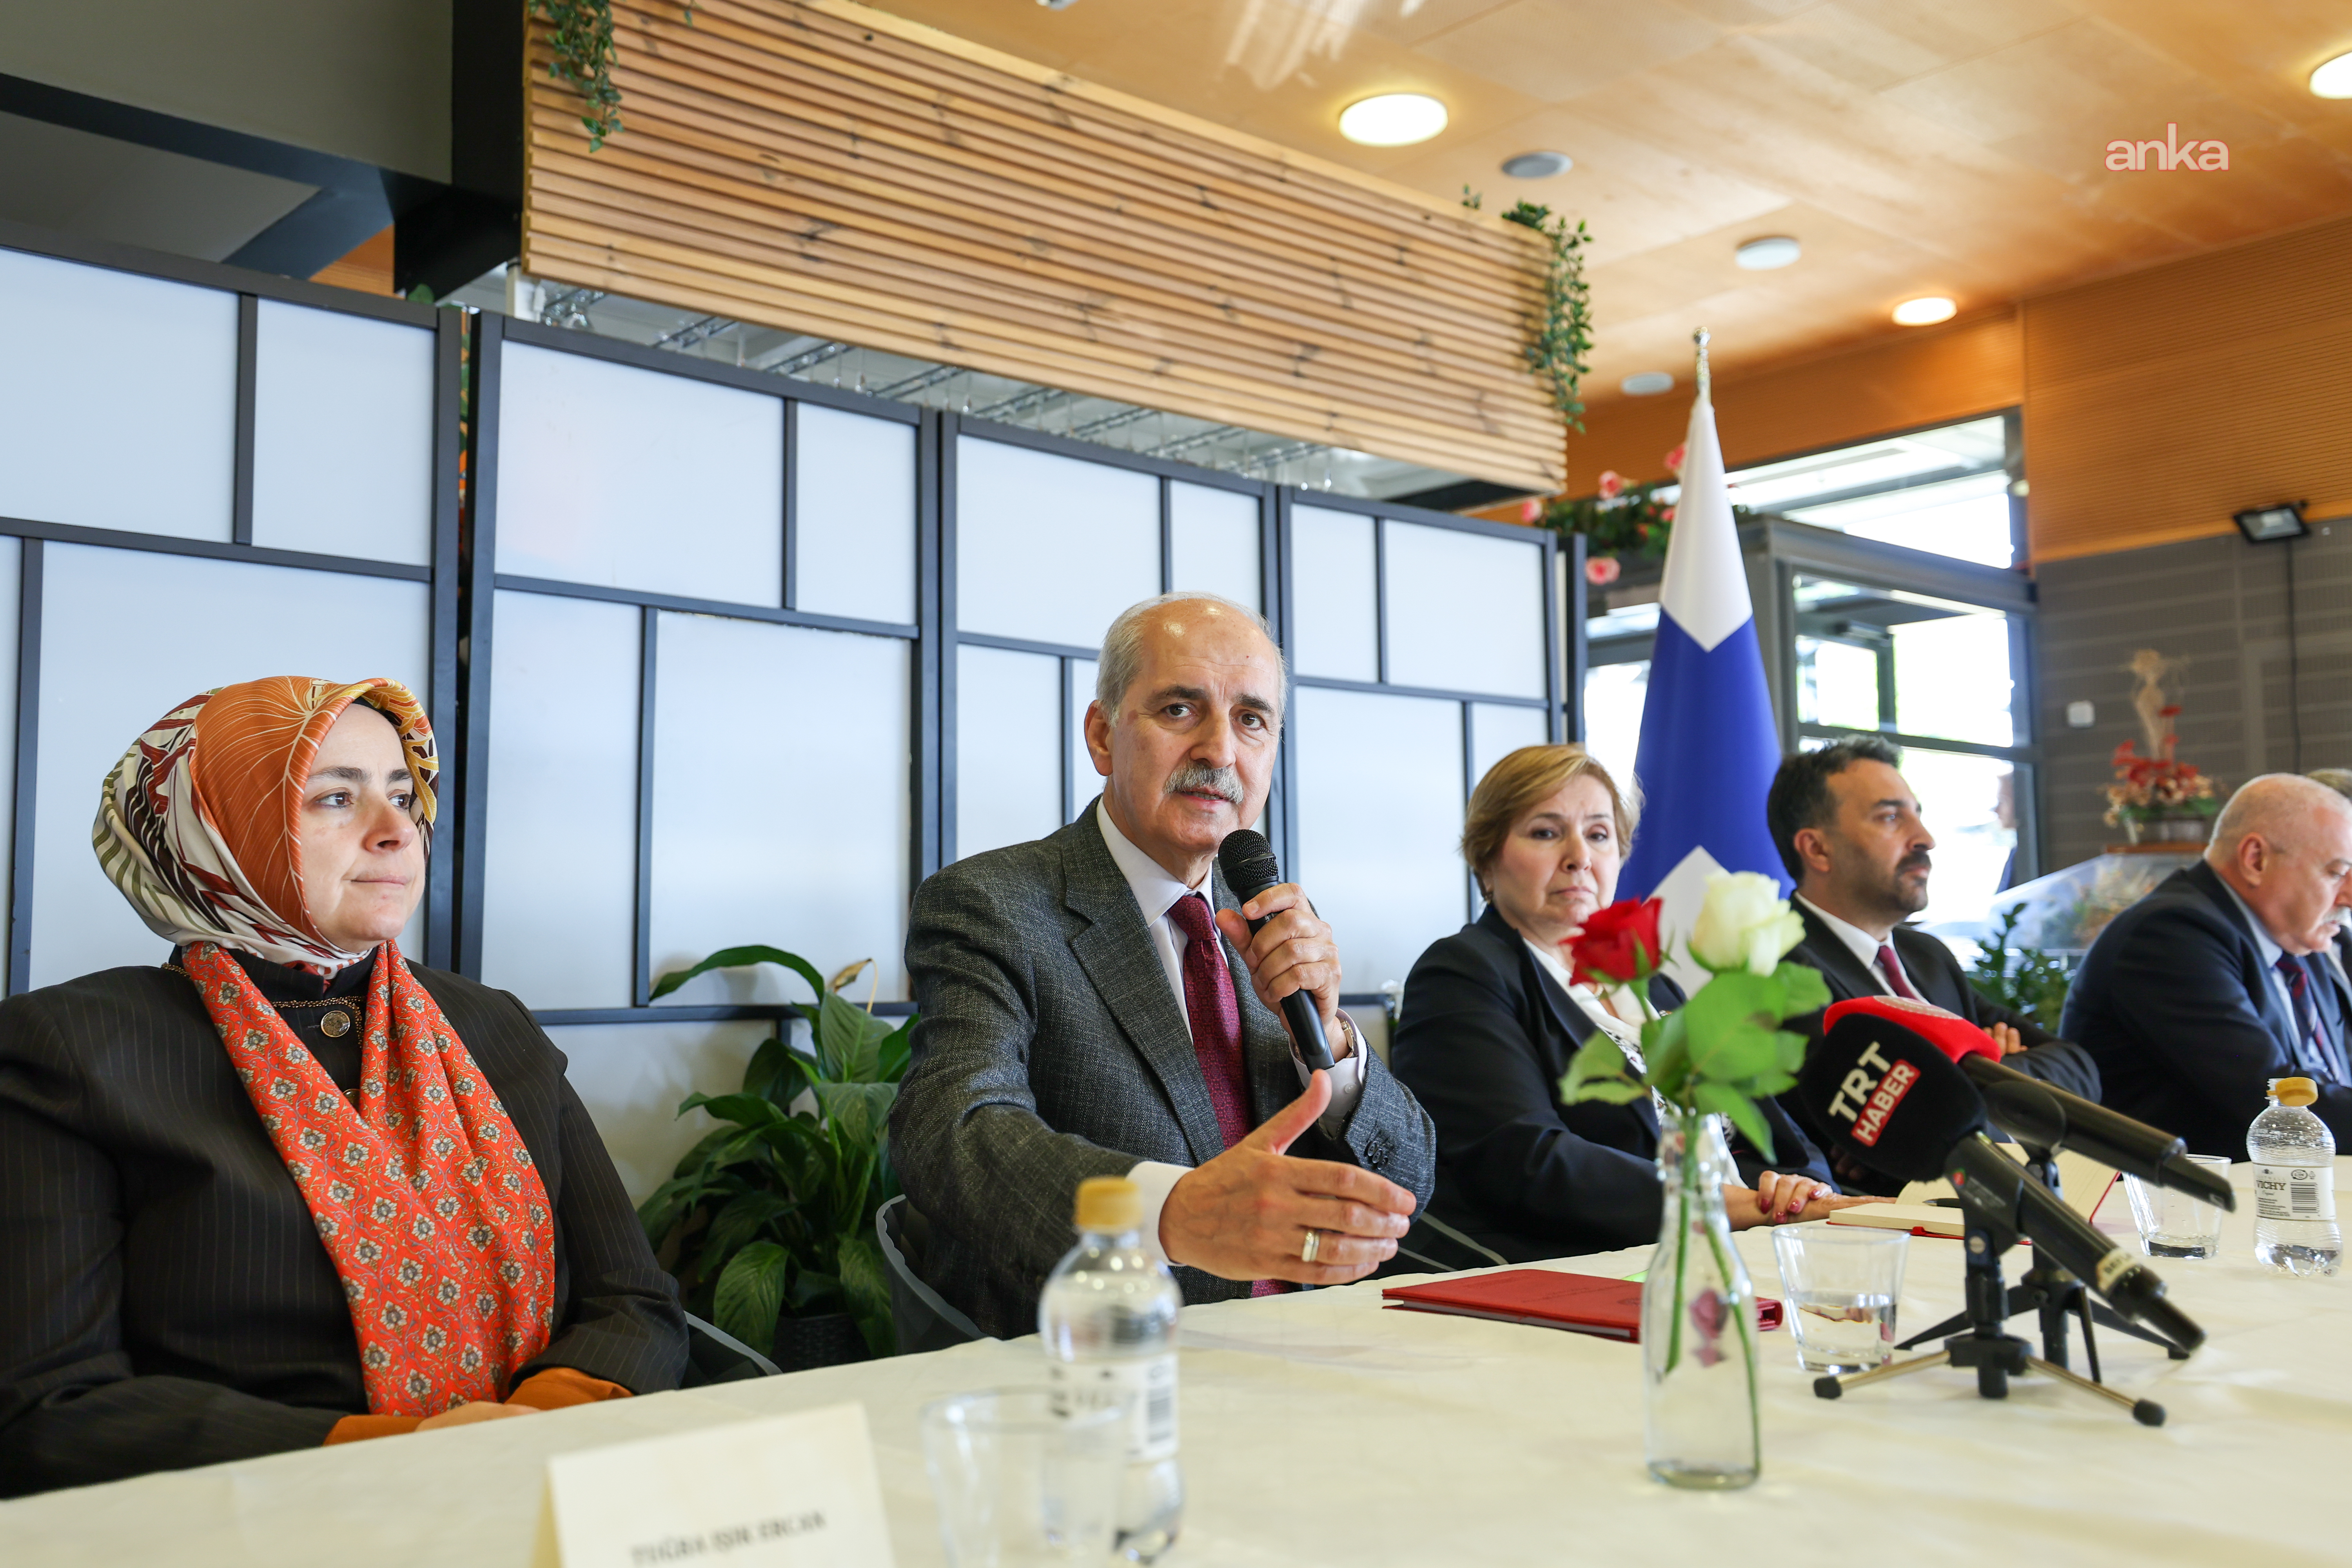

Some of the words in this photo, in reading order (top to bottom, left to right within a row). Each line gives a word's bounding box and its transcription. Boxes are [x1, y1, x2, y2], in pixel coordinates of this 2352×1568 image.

[1828, 1041, 1891, 1122] TRT
[1857, 1064, 1915, 1141] HABER
[2256, 1180, 2287, 1190] VICHY
